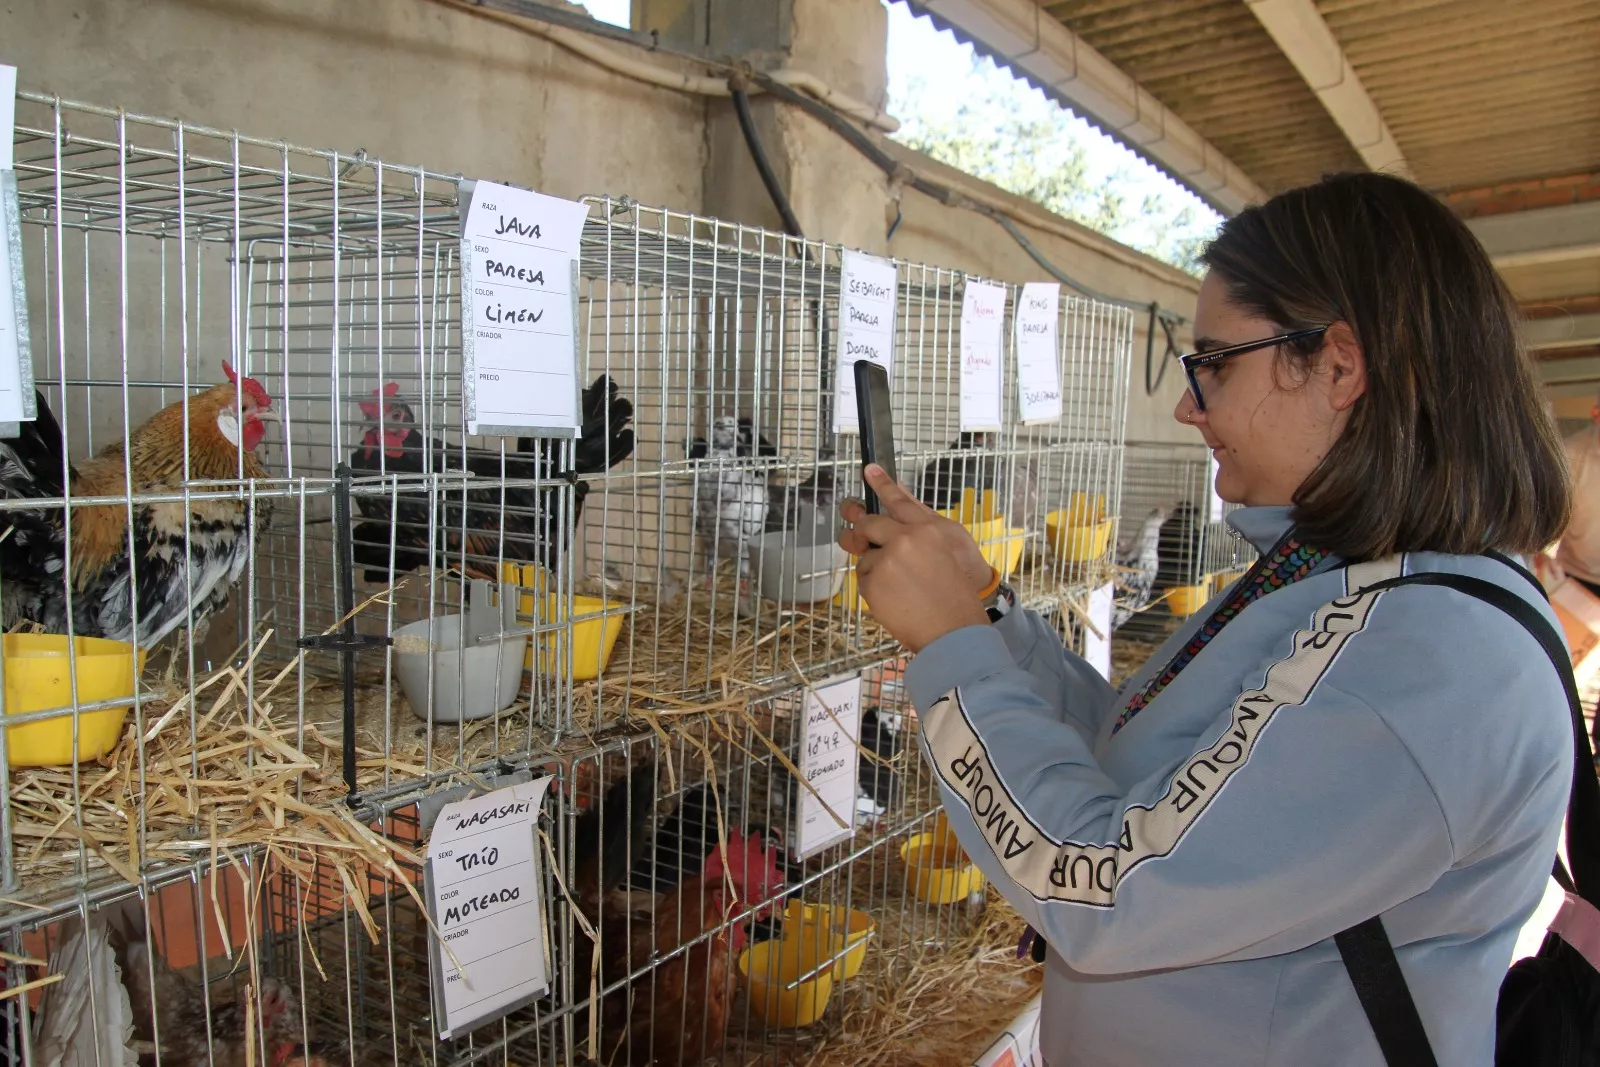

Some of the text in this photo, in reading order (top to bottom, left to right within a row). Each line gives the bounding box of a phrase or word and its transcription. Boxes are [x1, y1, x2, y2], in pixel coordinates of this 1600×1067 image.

[482, 202, 497, 211] RAZA
[495, 215, 541, 239] JAVA
[474, 245, 489, 253] SEXO
[486, 260, 544, 285] PAREJA
[475, 288, 494, 296] COLOR
[477, 331, 502, 339] CRIADOR
[480, 373, 499, 381] PRECIO
[951, 746, 1034, 860] AMOUR
[438, 850, 453, 859] SEXO
[440, 890, 459, 900] COLOR
[444, 887, 519, 925] MOTEADO
[443, 928, 469, 941] CRIADOR
[446, 973, 462, 983] PREC
